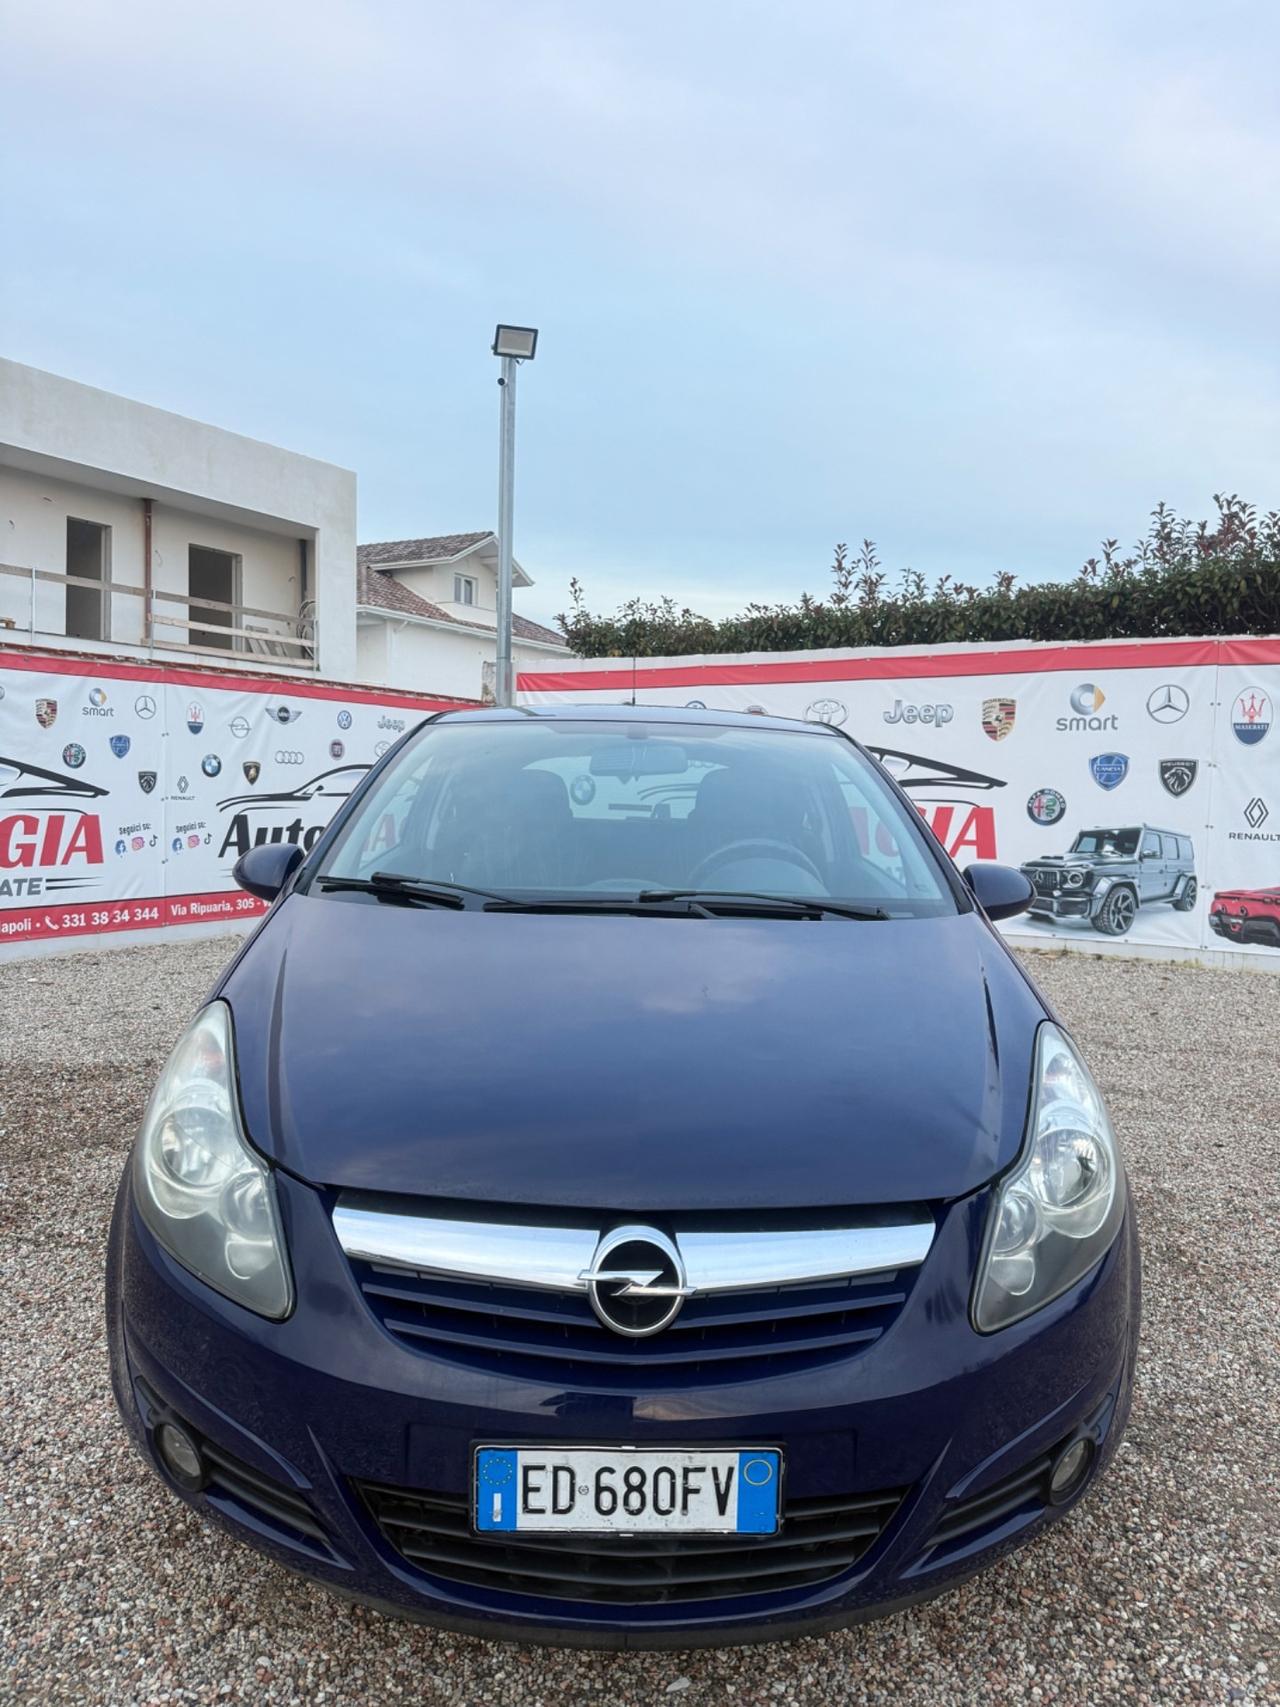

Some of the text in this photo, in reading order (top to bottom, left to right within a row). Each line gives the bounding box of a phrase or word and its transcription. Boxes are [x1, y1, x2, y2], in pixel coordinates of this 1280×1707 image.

[82, 706, 114, 717] smart
[883, 700, 954, 728] Jeep
[377, 715, 405, 733] Jeep
[1056, 714, 1119, 732] smart
[0, 815, 104, 868] GIA
[62, 913, 86, 928] 331
[91, 911, 109, 925] 38
[113, 908, 130, 923] 34
[134, 906, 159, 921] 344
[171, 904, 187, 916] Via
[190, 900, 234, 916] Ripuaria,
[236, 898, 254, 910] 305
[521, 1464, 735, 1518] ED 680FV
